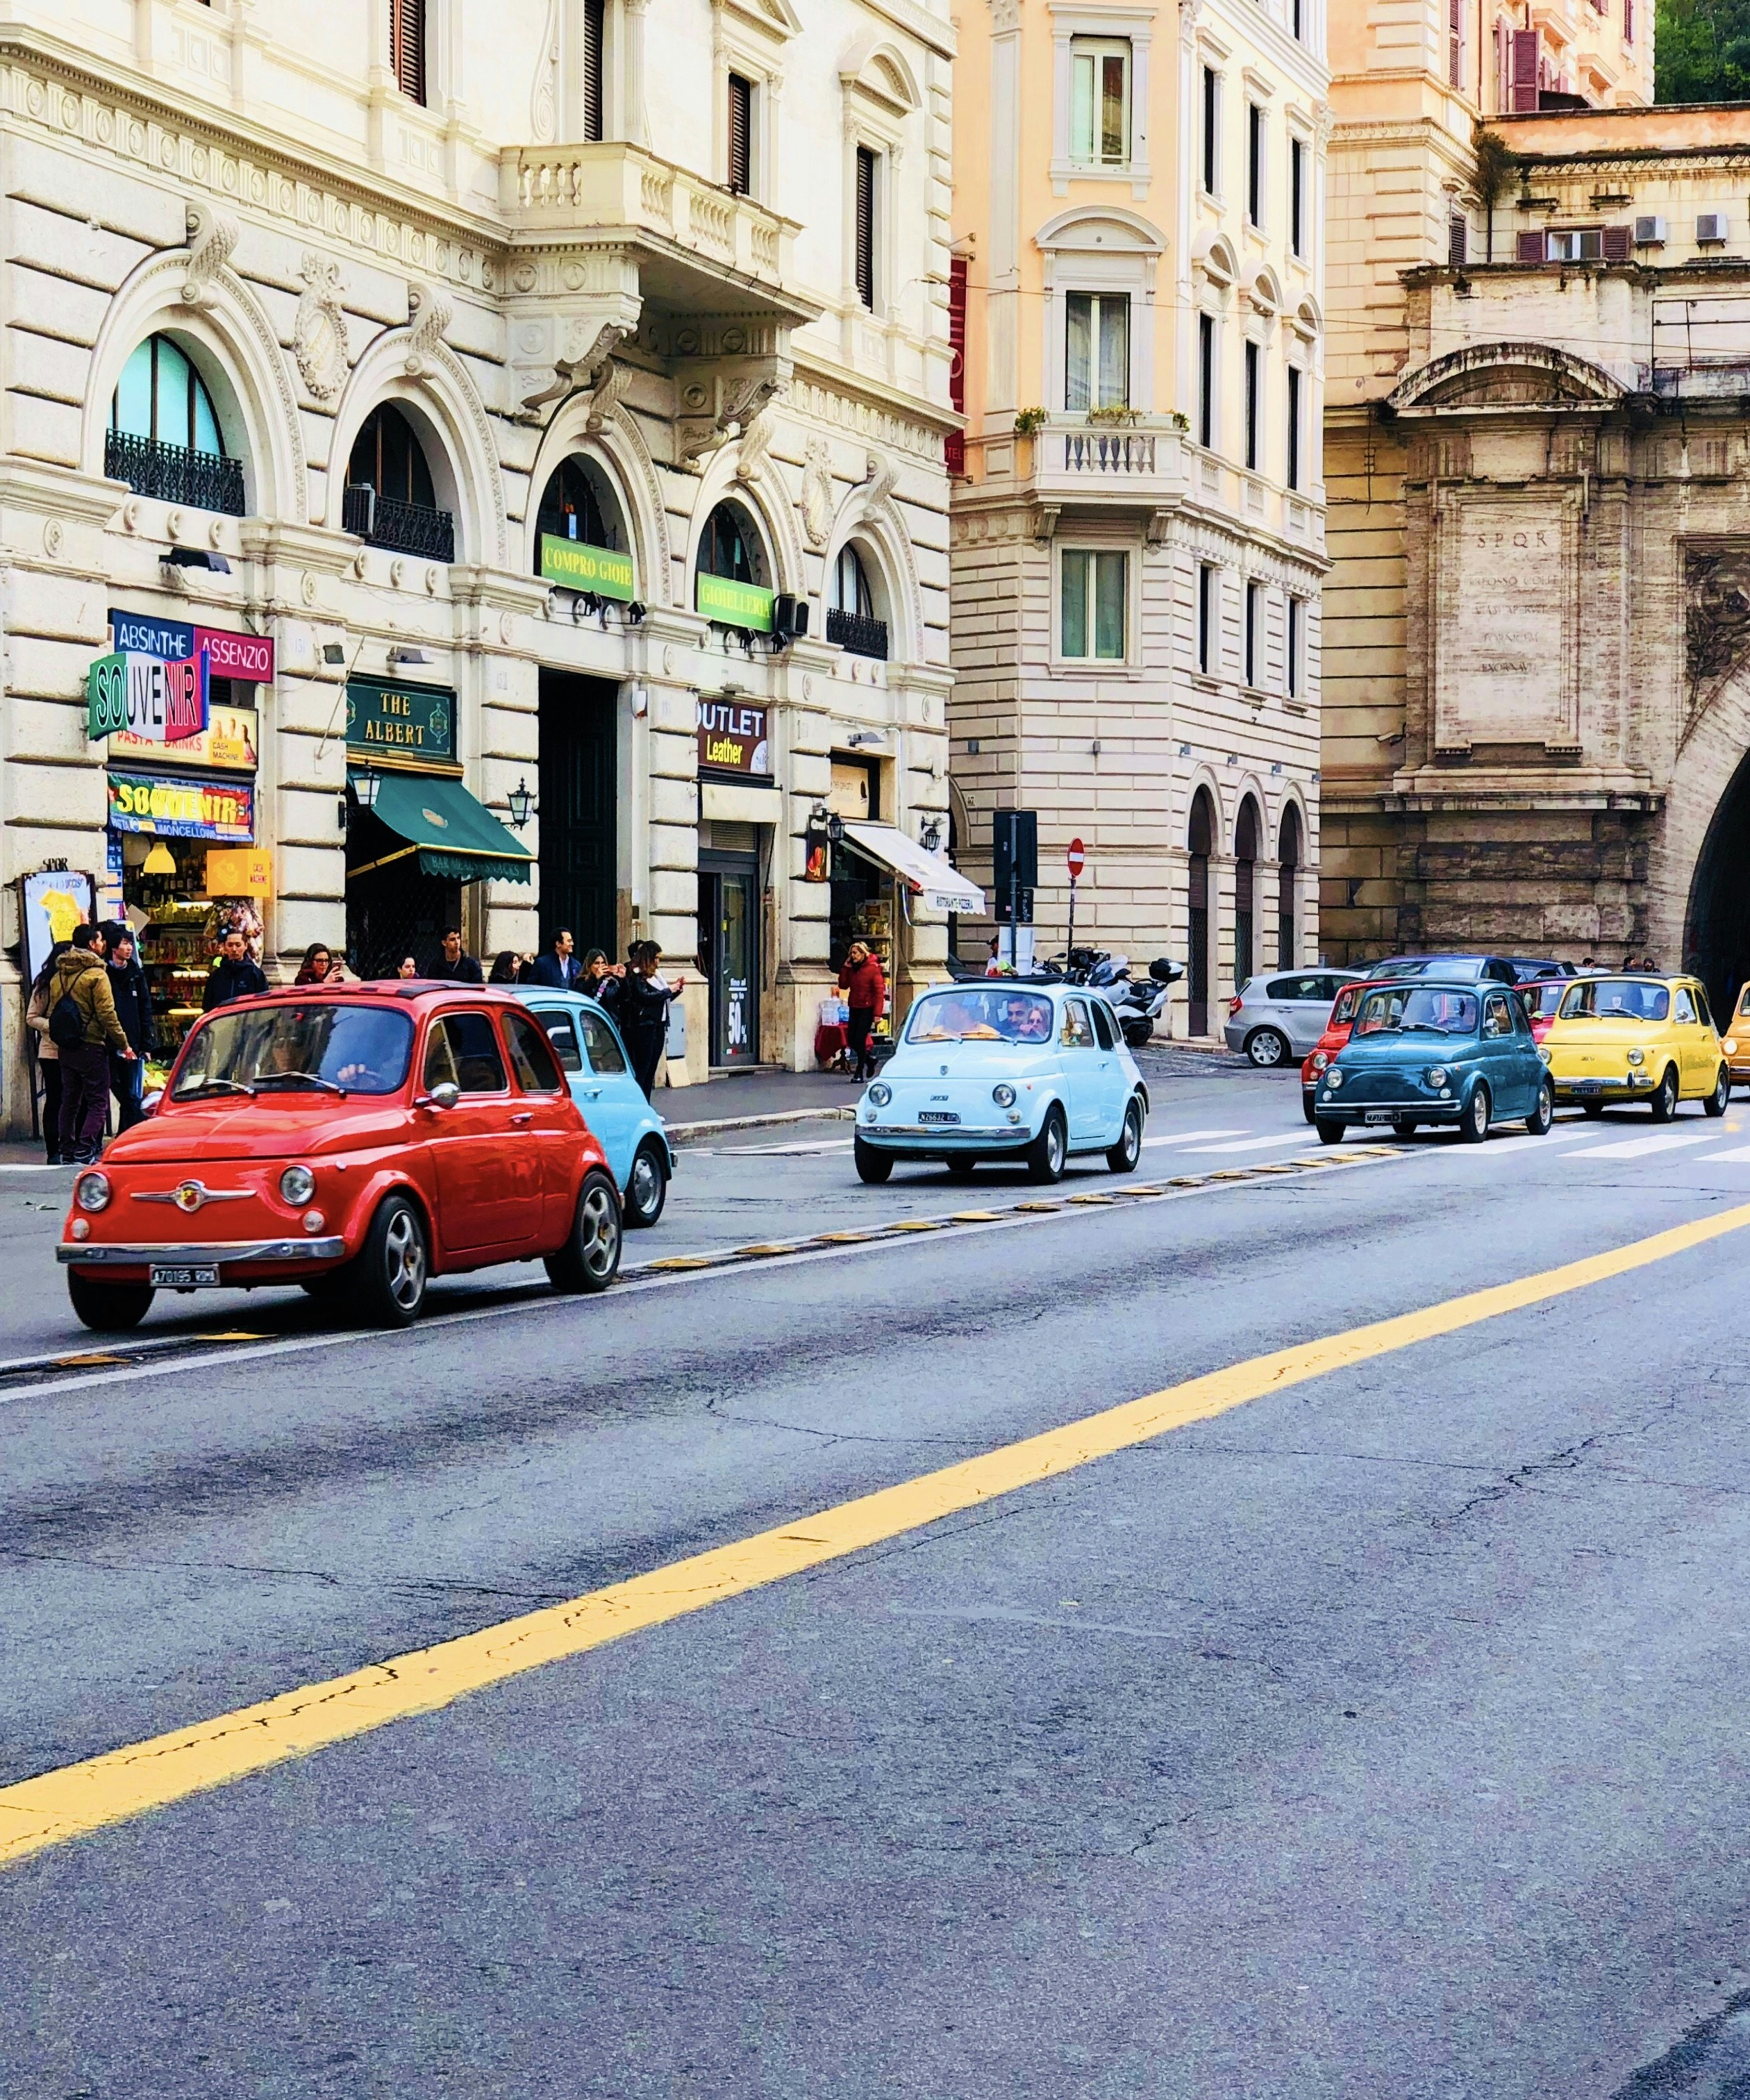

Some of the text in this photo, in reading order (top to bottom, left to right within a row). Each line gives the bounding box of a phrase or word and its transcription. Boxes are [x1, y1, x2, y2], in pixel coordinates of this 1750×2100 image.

[544, 547, 633, 587] COMPRO GIOIE
[701, 583, 772, 617] GIOIELLERIA
[119, 623, 187, 658] ABSINTHE
[202, 637, 269, 672] ASSENZIO
[96, 663, 199, 728] SOUVENIR
[380, 692, 411, 717] THE
[212, 741, 228, 751] CASH
[365, 719, 425, 746] ALBERT
[212, 751, 240, 762] MACHINE
[706, 734, 743, 765] Leather
[432, 855, 449, 869] BAR
